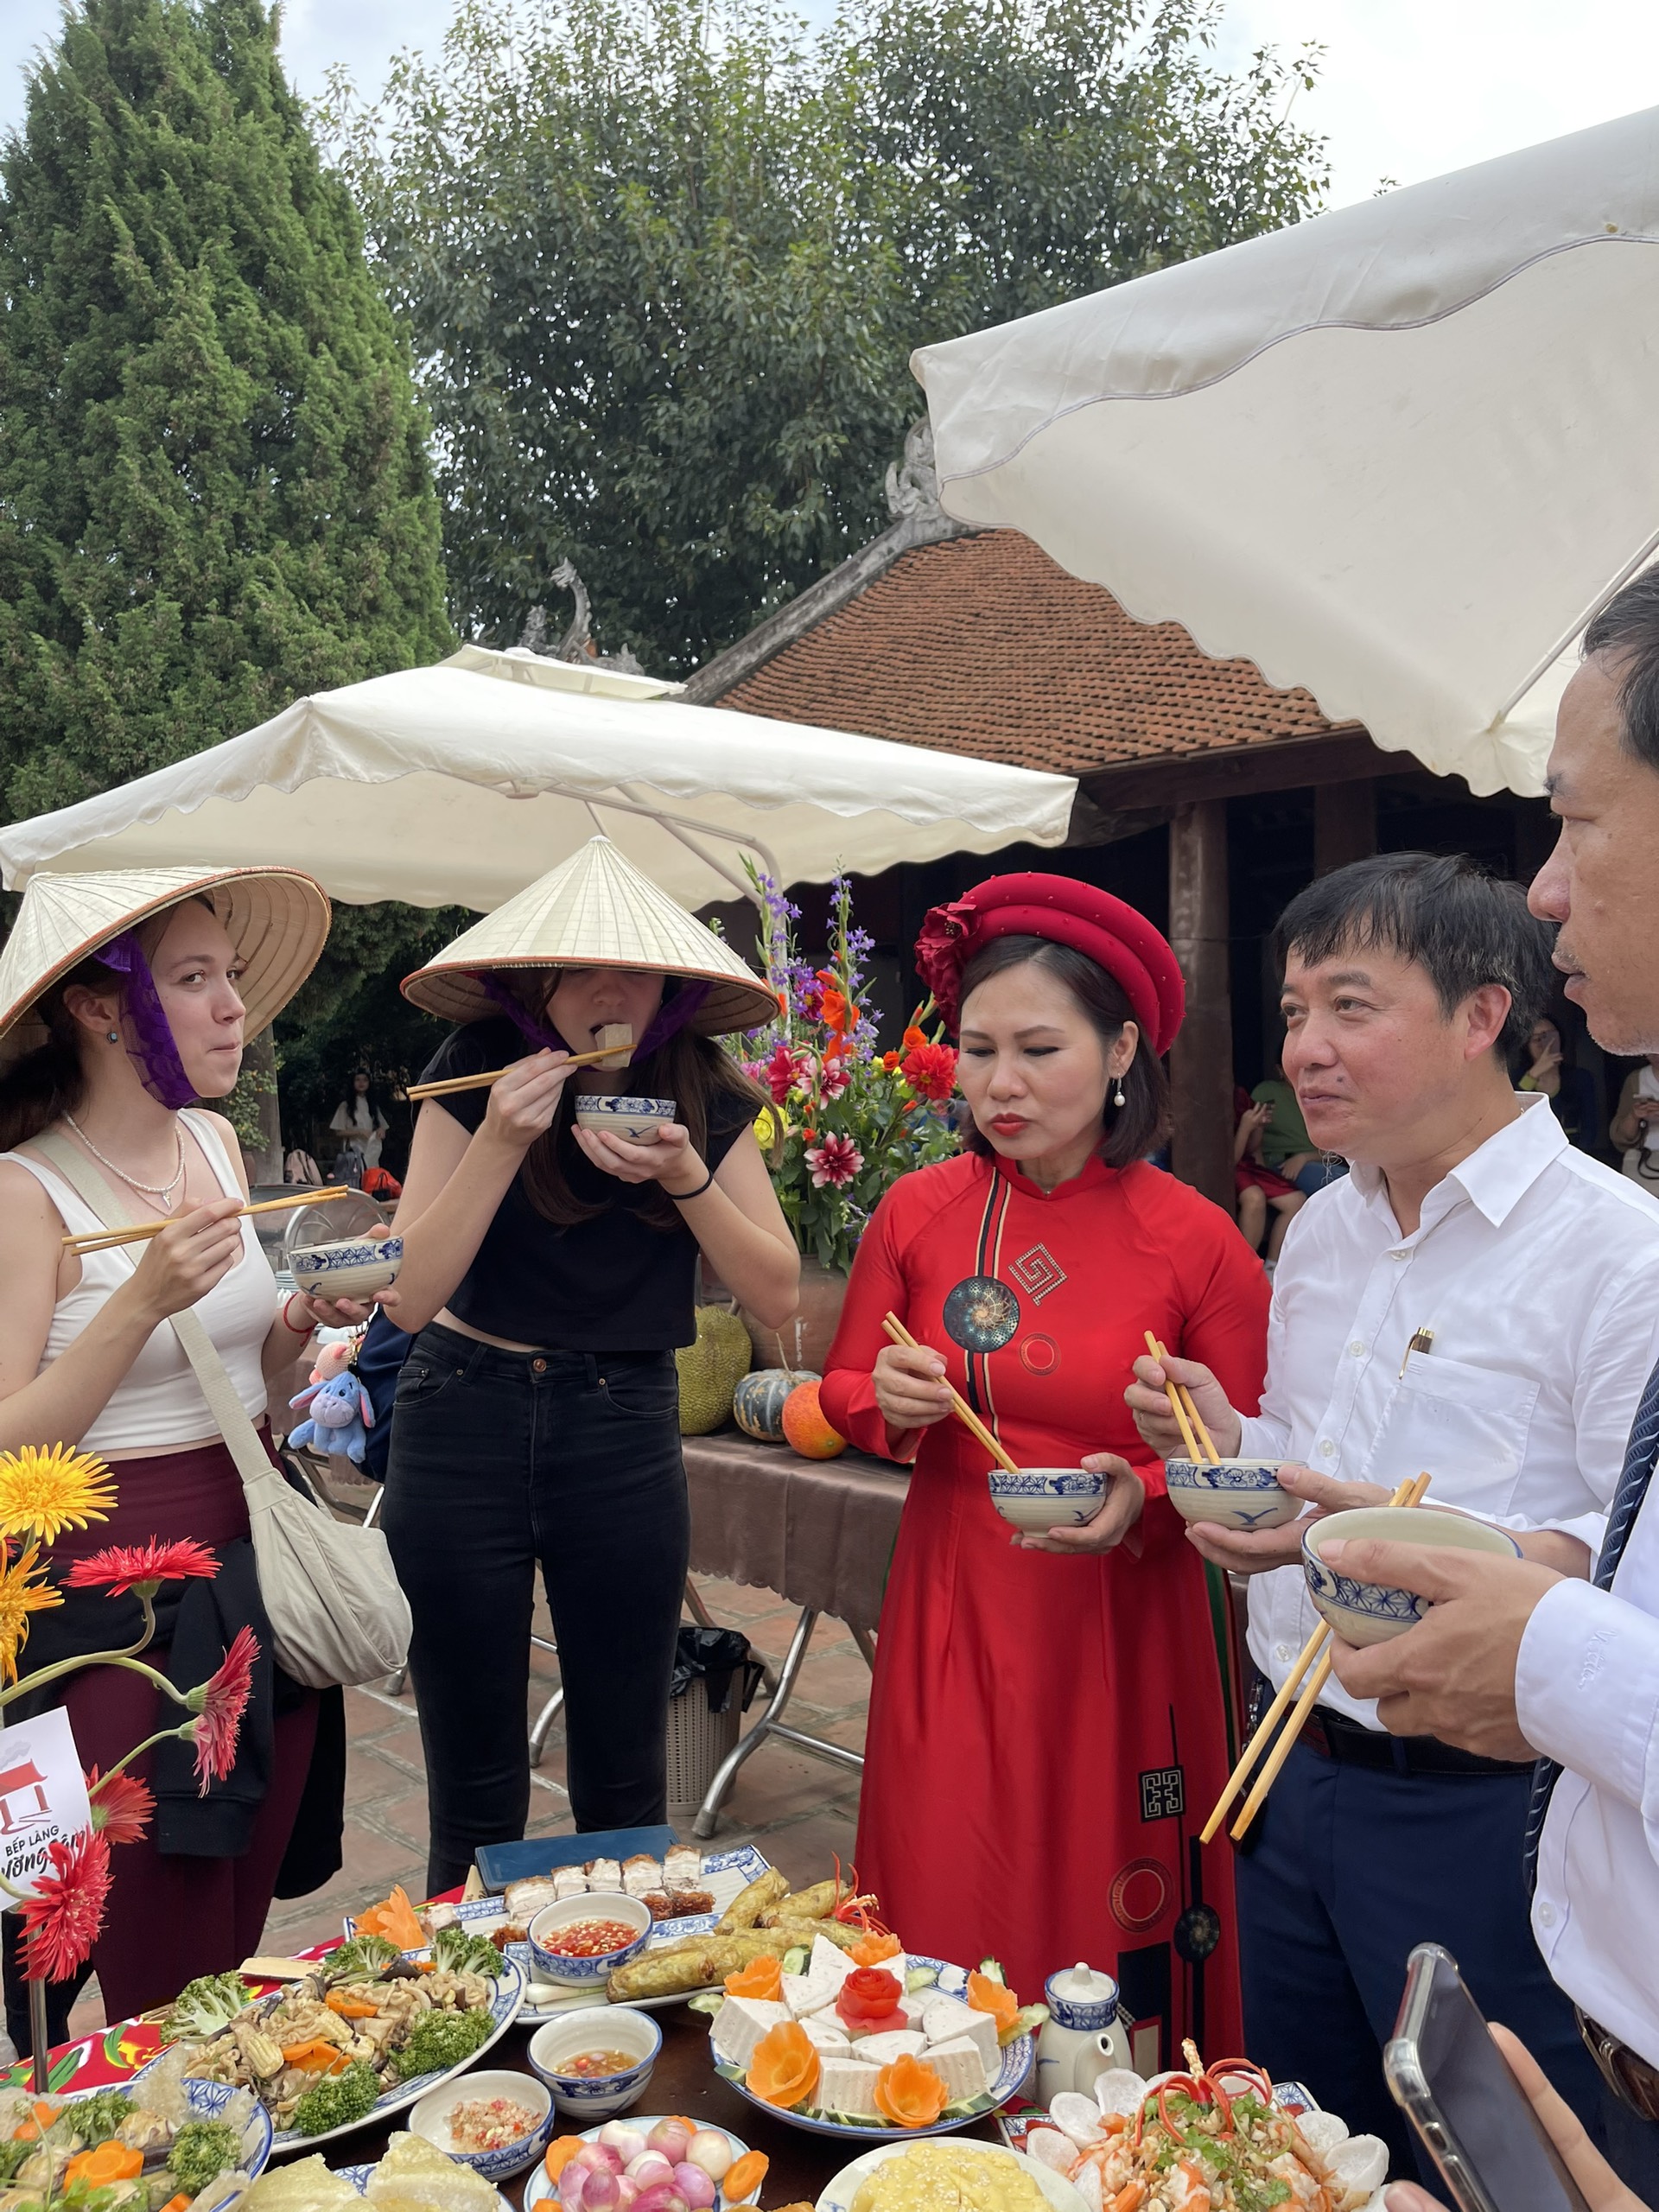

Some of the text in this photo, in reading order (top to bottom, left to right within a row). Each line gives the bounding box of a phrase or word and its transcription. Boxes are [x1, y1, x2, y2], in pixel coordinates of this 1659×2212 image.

[5, 1825, 60, 1857] BẾP LÀNG
[0, 1847, 48, 1880] ường
